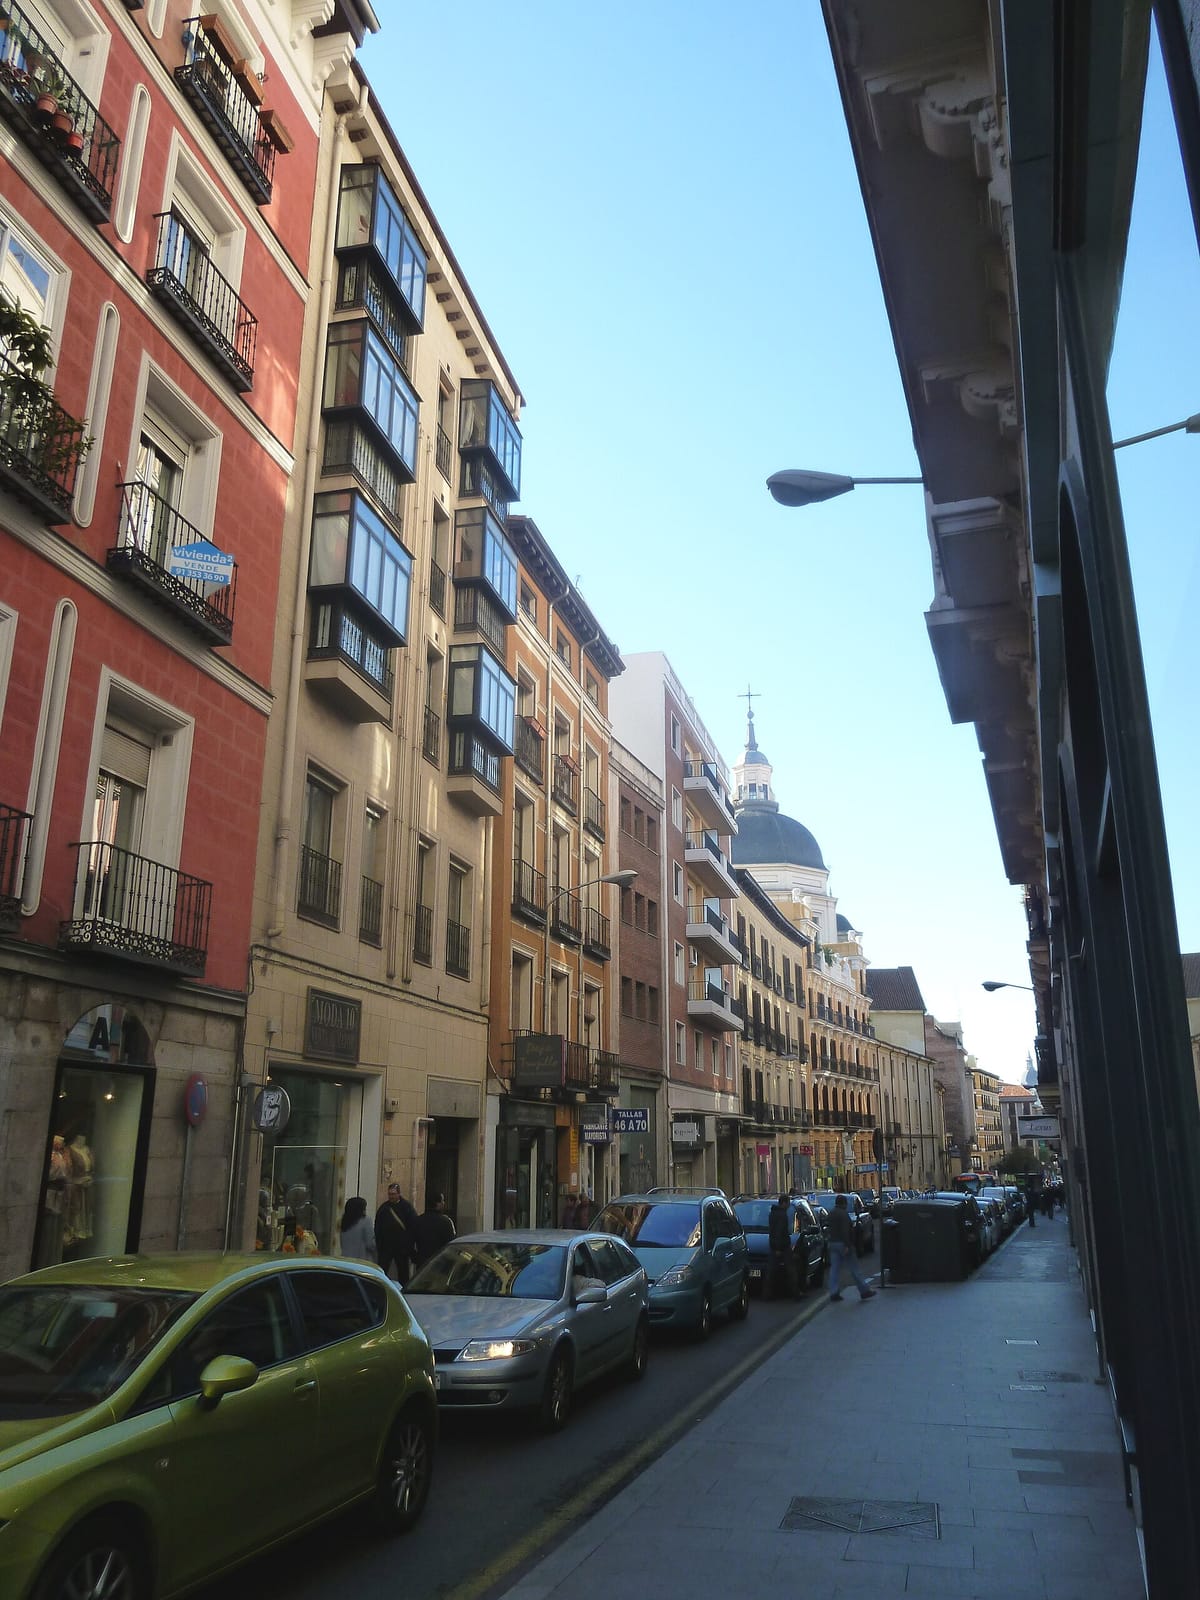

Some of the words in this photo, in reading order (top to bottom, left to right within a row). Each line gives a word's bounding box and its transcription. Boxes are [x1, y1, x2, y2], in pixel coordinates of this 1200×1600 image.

[184, 561, 219, 572] VENDE
[615, 1120, 626, 1131] 46
[628, 1120, 635, 1131] A
[636, 1120, 647, 1131] 70
